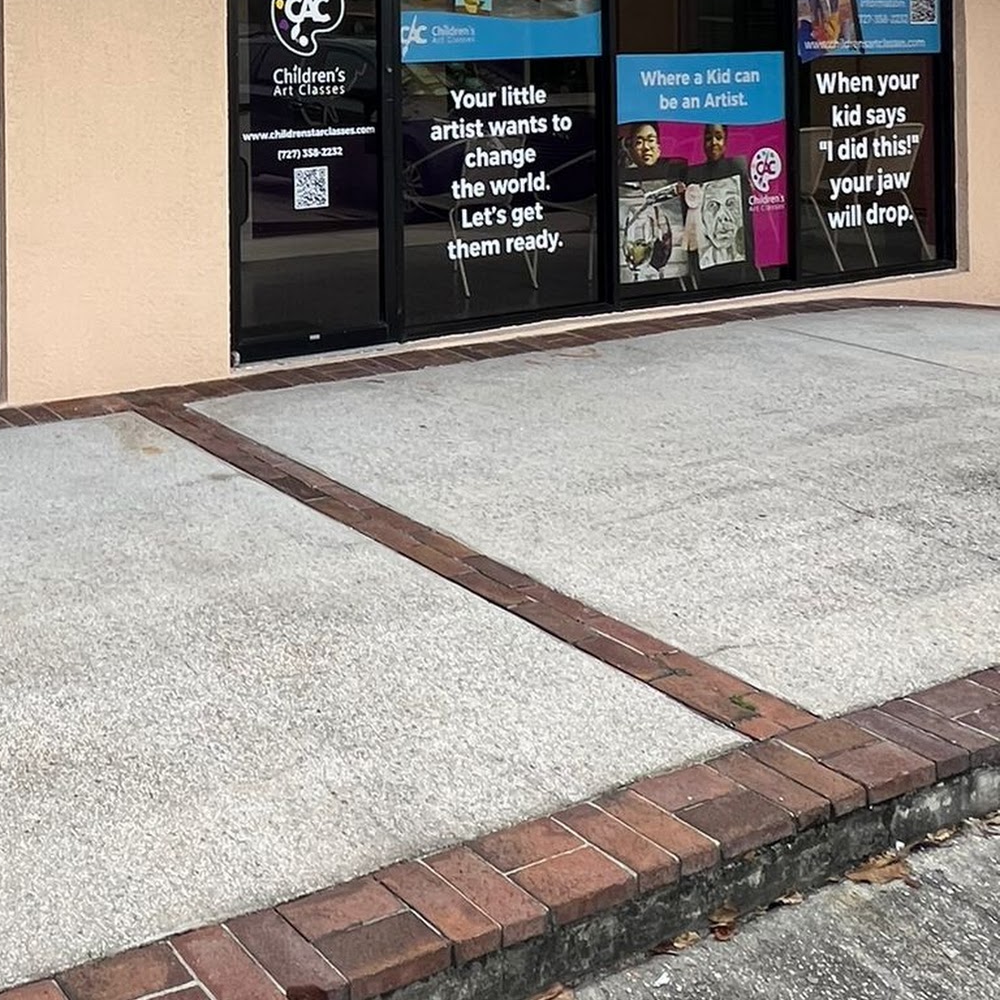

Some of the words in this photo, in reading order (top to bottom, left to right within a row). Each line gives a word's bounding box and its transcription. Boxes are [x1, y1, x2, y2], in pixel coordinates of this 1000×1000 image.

[273, 65, 346, 84] Children's
[641, 70, 692, 87] Where
[694, 73, 703, 85] a
[706, 68, 731, 85] Kid
[734, 70, 760, 84] can
[816, 71, 873, 94] When
[877, 73, 919, 96] your
[273, 85, 294, 96] Art
[299, 84, 346, 96] Classes
[451, 90, 497, 109] Your
[501, 85, 547, 106] little
[659, 95, 678, 110] be
[682, 96, 701, 109] an
[704, 92, 749, 108] Artist.
[430, 118, 484, 141] artist
[488, 115, 548, 137] wants
[552, 114, 573, 133] to
[832, 104, 861, 127] kid
[866, 106, 906, 129] says
[278, 149, 301, 161] (727)
[302, 146, 343, 158] 358-2232
[465, 147, 537, 169] change
[837, 137, 867, 161] did
[451, 178, 485, 199] the
[489, 171, 550, 196] world.
[830, 175, 873, 200] your
[876, 167, 911, 196] jaw
[461, 206, 507, 228] Let's
[511, 202, 543, 227] get
[828, 204, 861, 229] will
[865, 202, 914, 227] drop.
[447, 238, 500, 260] them
[506, 229, 563, 253] ready.
